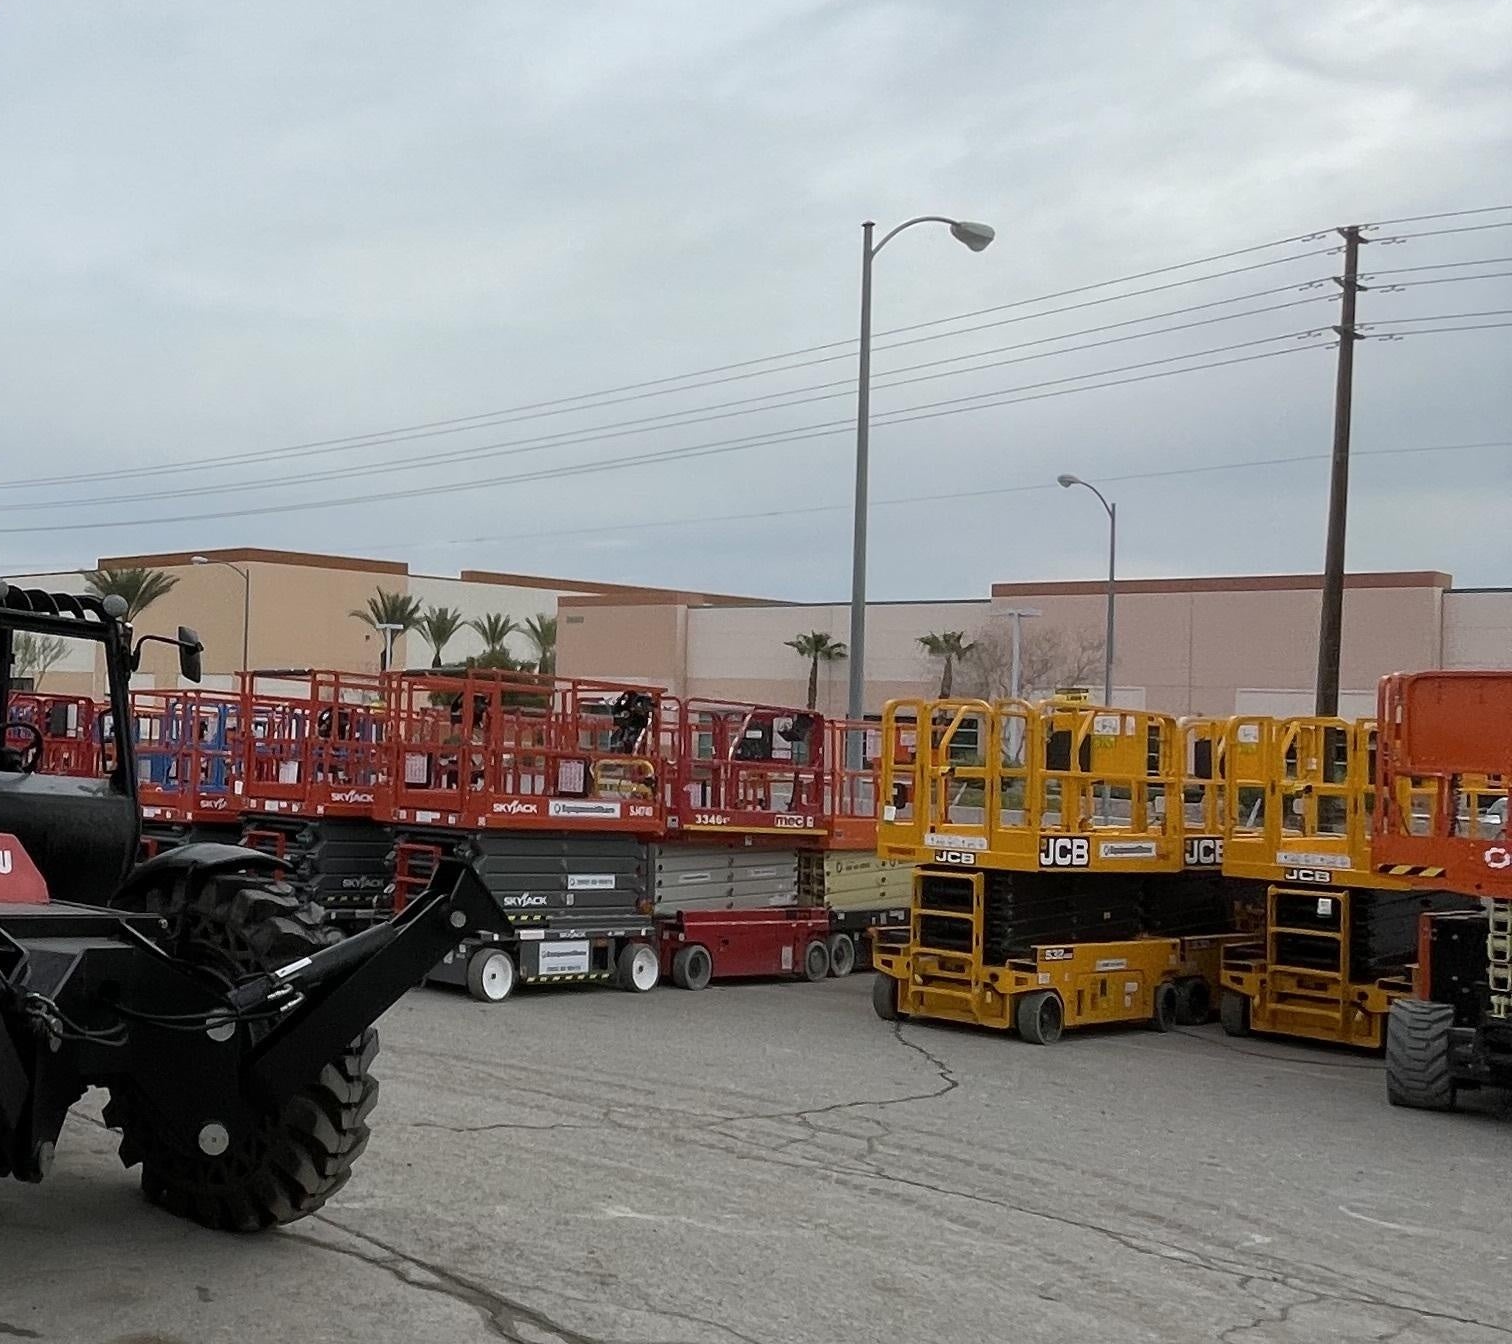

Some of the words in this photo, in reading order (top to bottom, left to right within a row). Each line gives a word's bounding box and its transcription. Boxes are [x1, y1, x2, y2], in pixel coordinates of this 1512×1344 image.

[331, 790, 374, 803] SKYJACK
[493, 800, 537, 814] SKYJACK
[935, 850, 975, 864] JCB
[1039, 838, 1088, 866] JCB
[1285, 868, 1331, 882] JCB
[503, 892, 547, 907] SKYJACK
